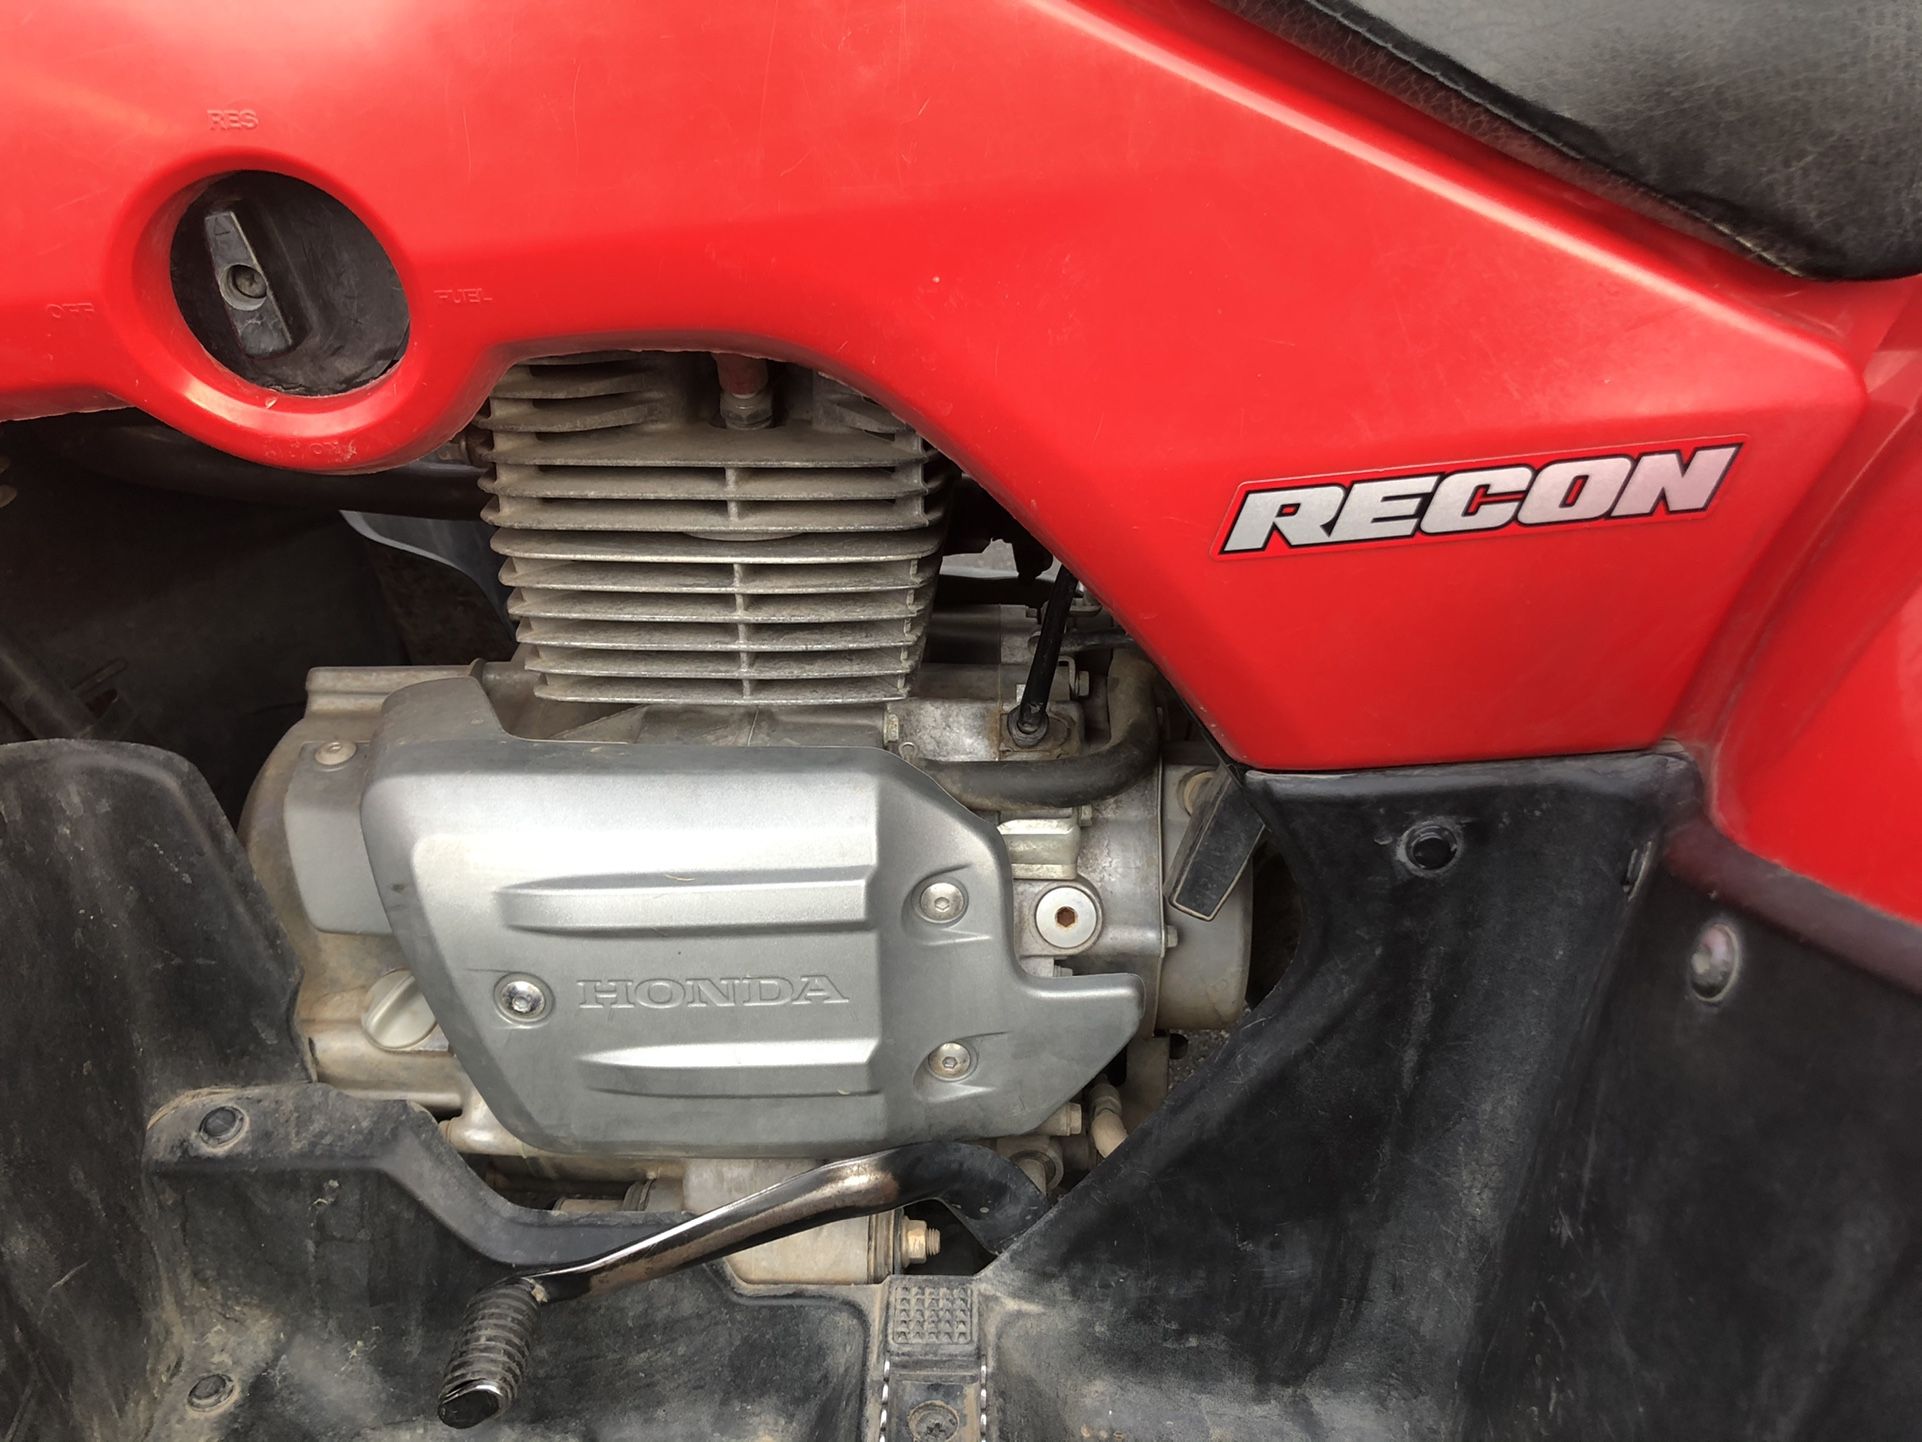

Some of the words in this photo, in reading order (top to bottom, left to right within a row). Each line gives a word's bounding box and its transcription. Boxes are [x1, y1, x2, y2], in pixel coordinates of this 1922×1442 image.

[206, 108, 259, 131] RES
[1219, 442, 1743, 555] RECON
[576, 974, 850, 1010] HONDA
